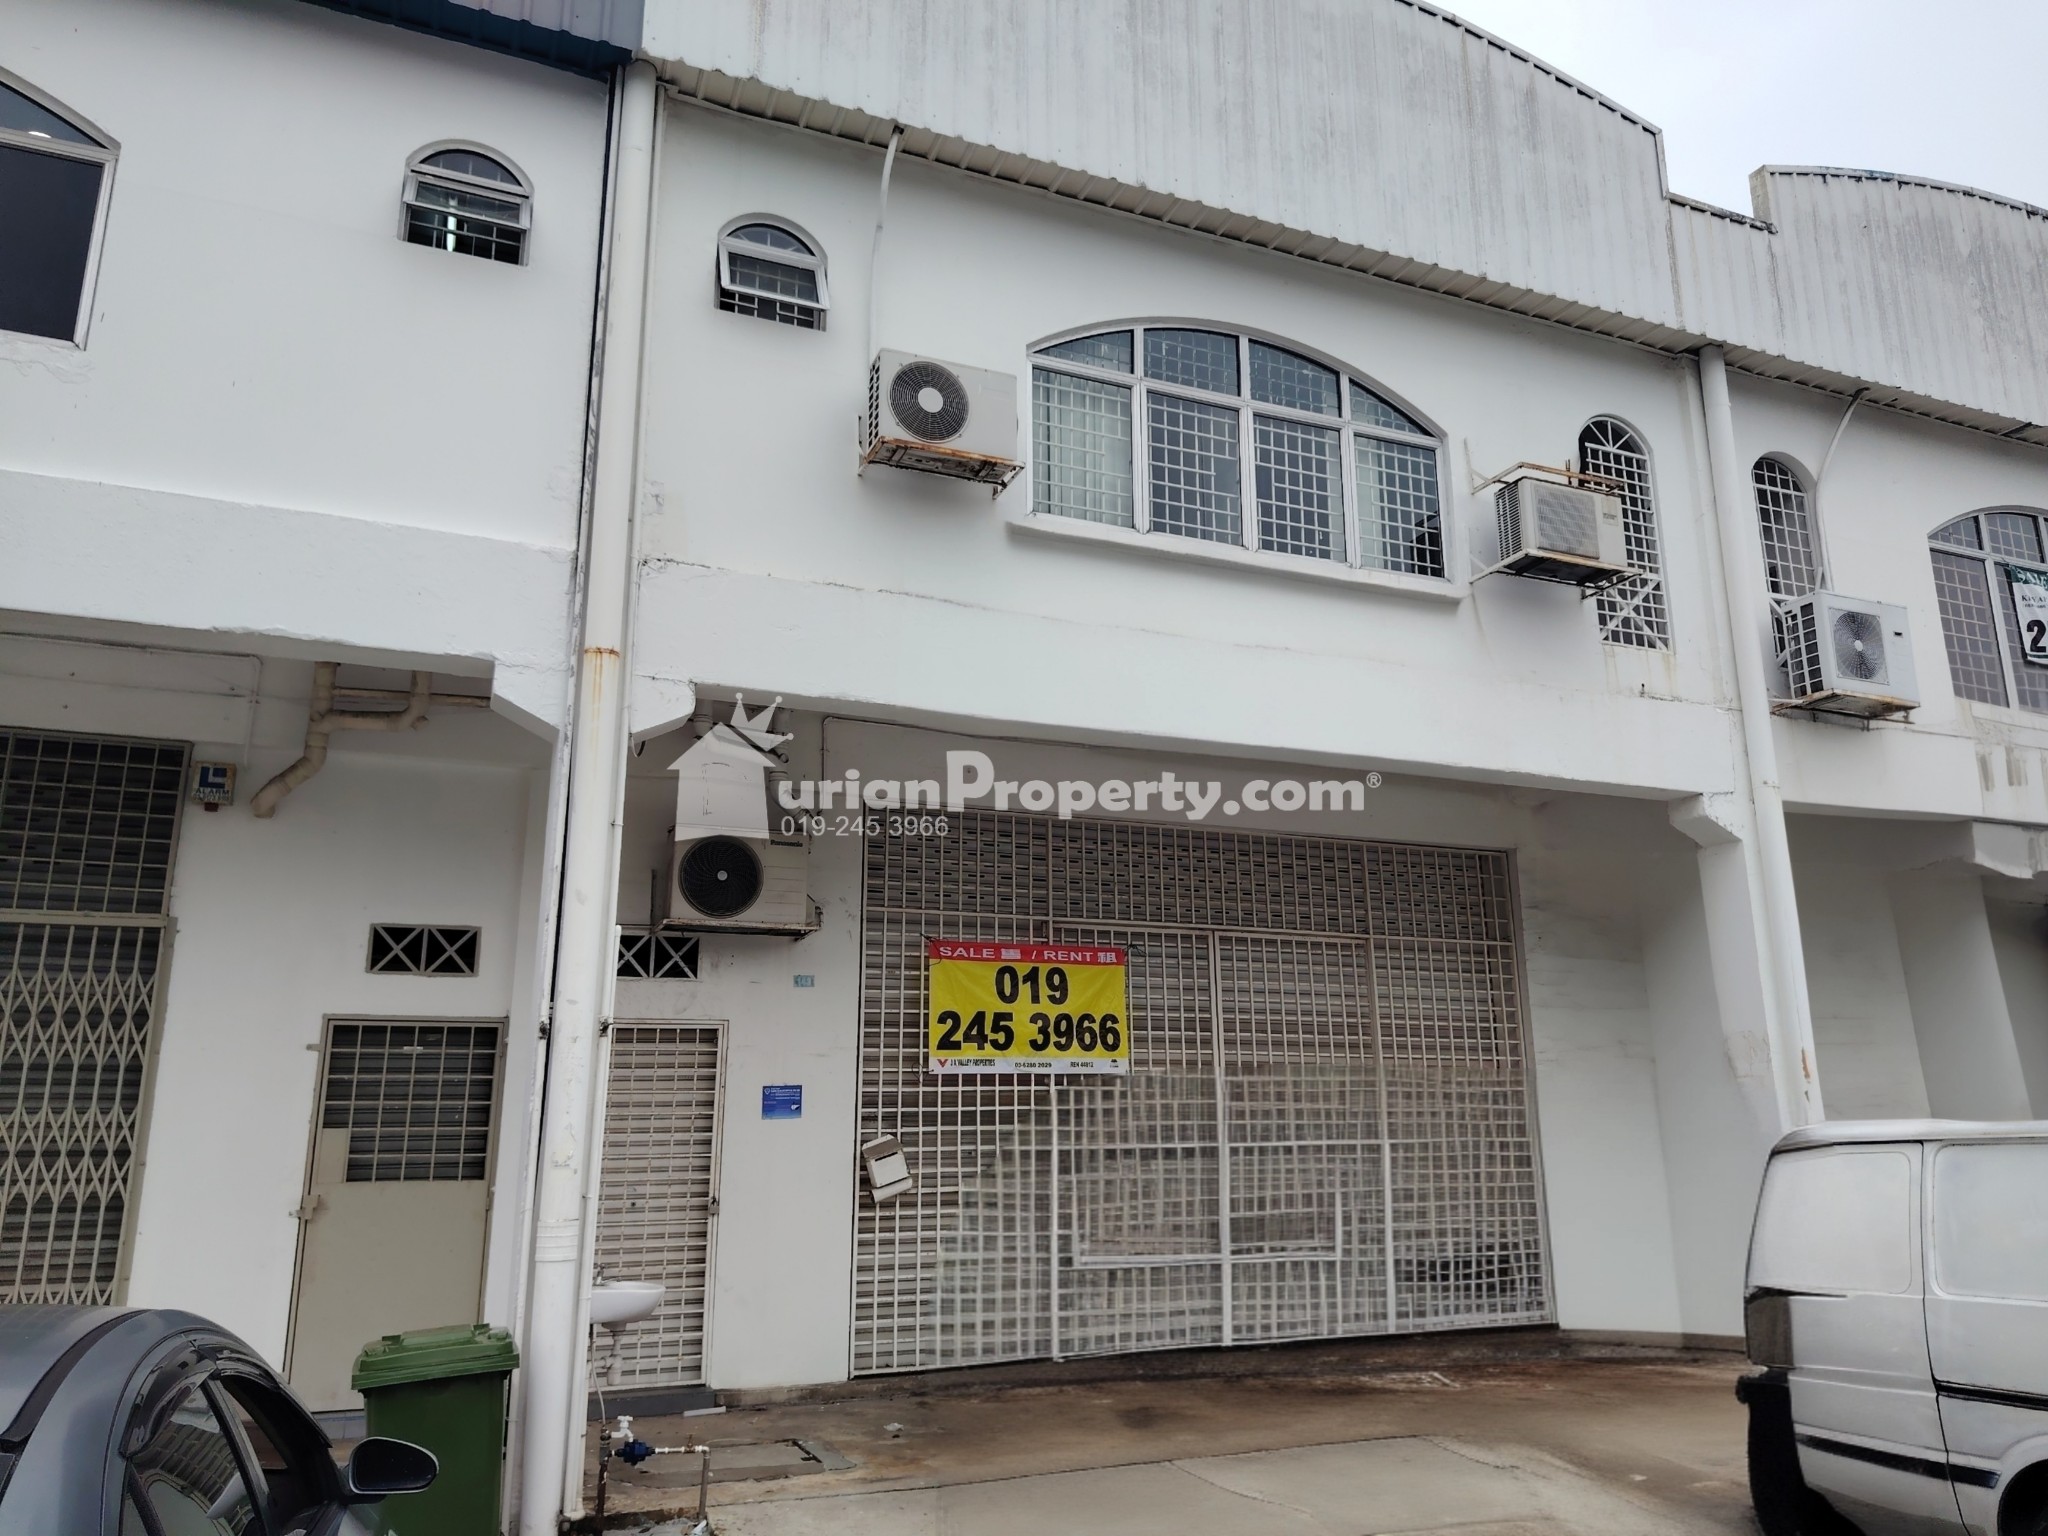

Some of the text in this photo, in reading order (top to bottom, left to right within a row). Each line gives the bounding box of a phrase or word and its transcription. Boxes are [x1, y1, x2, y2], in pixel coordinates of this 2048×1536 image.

[770, 839, 803, 848] Panasonic
[939, 946, 996, 959] SALE
[1031, 950, 1037, 960] /
[1043, 950, 1094, 962] RENT
[994, 965, 1069, 1005] 019
[936, 1010, 1121, 1052] 245 3966
